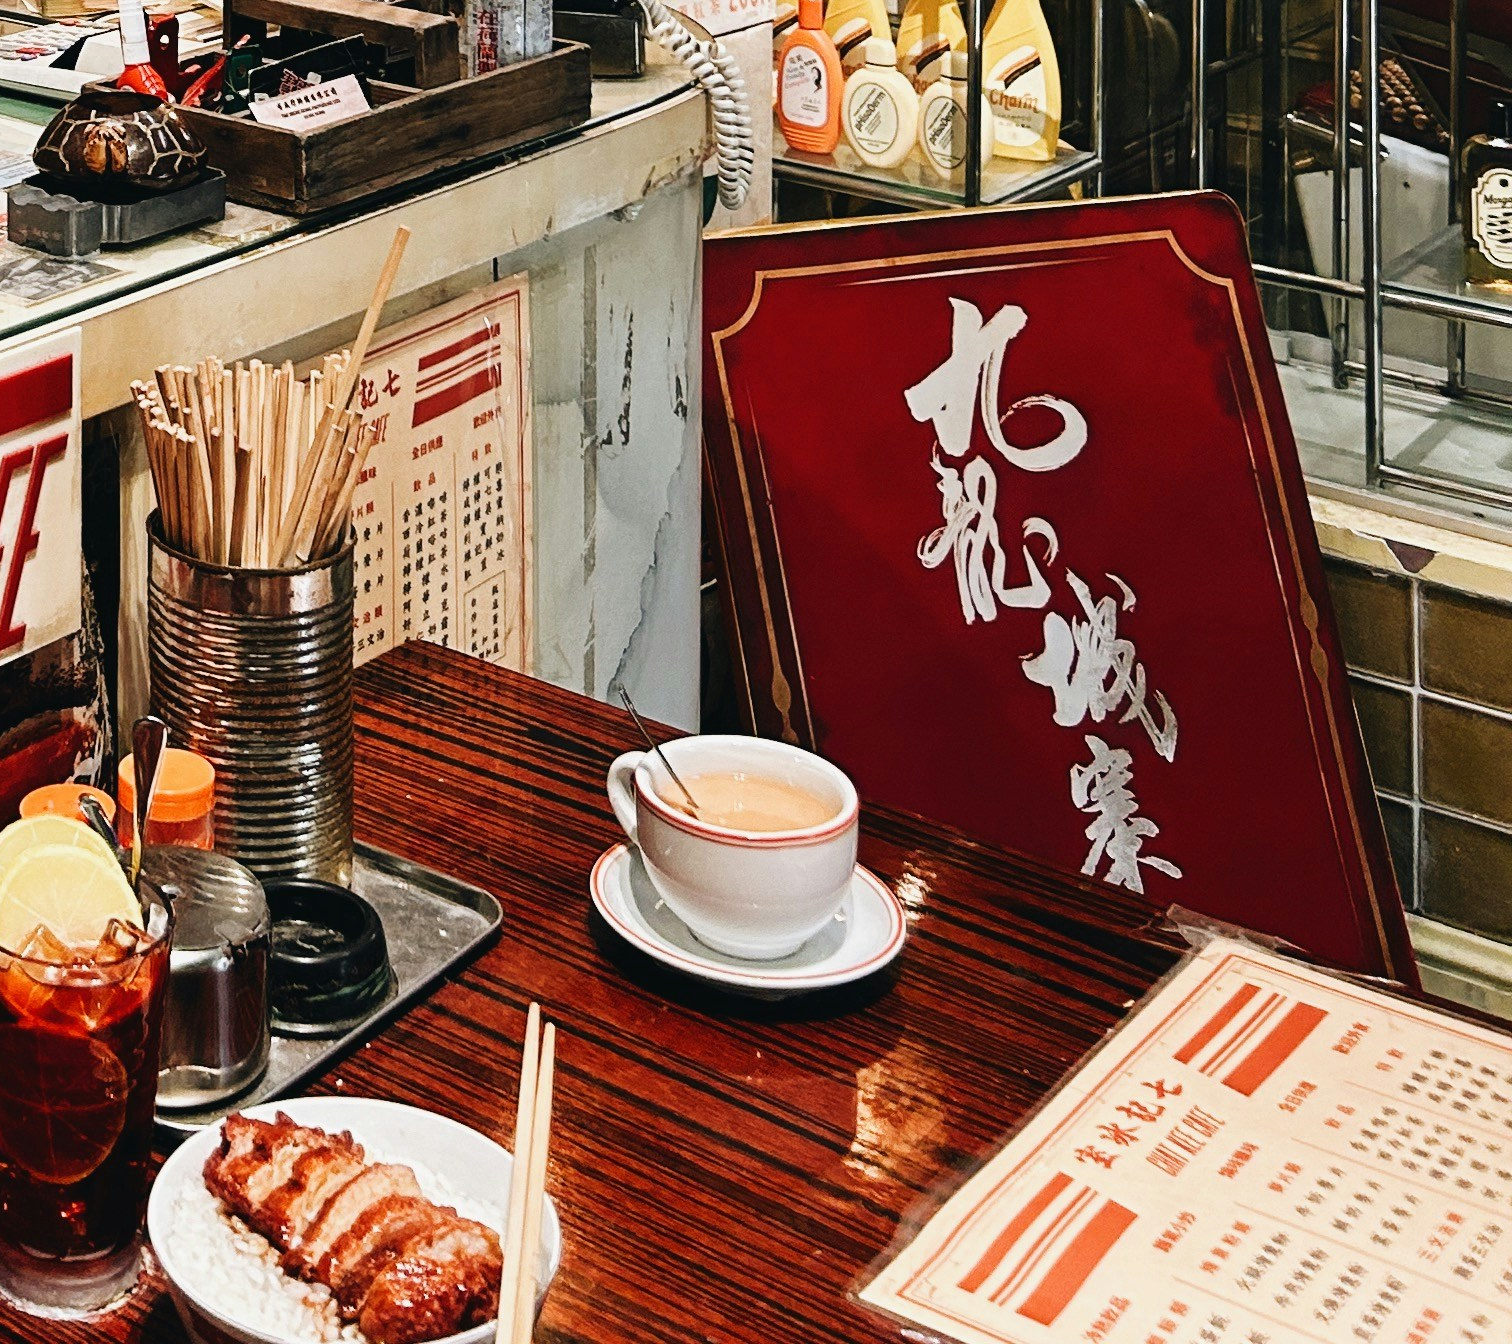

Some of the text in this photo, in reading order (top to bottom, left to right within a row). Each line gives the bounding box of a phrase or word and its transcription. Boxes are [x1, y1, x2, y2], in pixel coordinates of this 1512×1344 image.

[903, 297, 1183, 895] 九龍城寨
[1145, 1104, 1226, 1178] CHAT KEE CAFE
